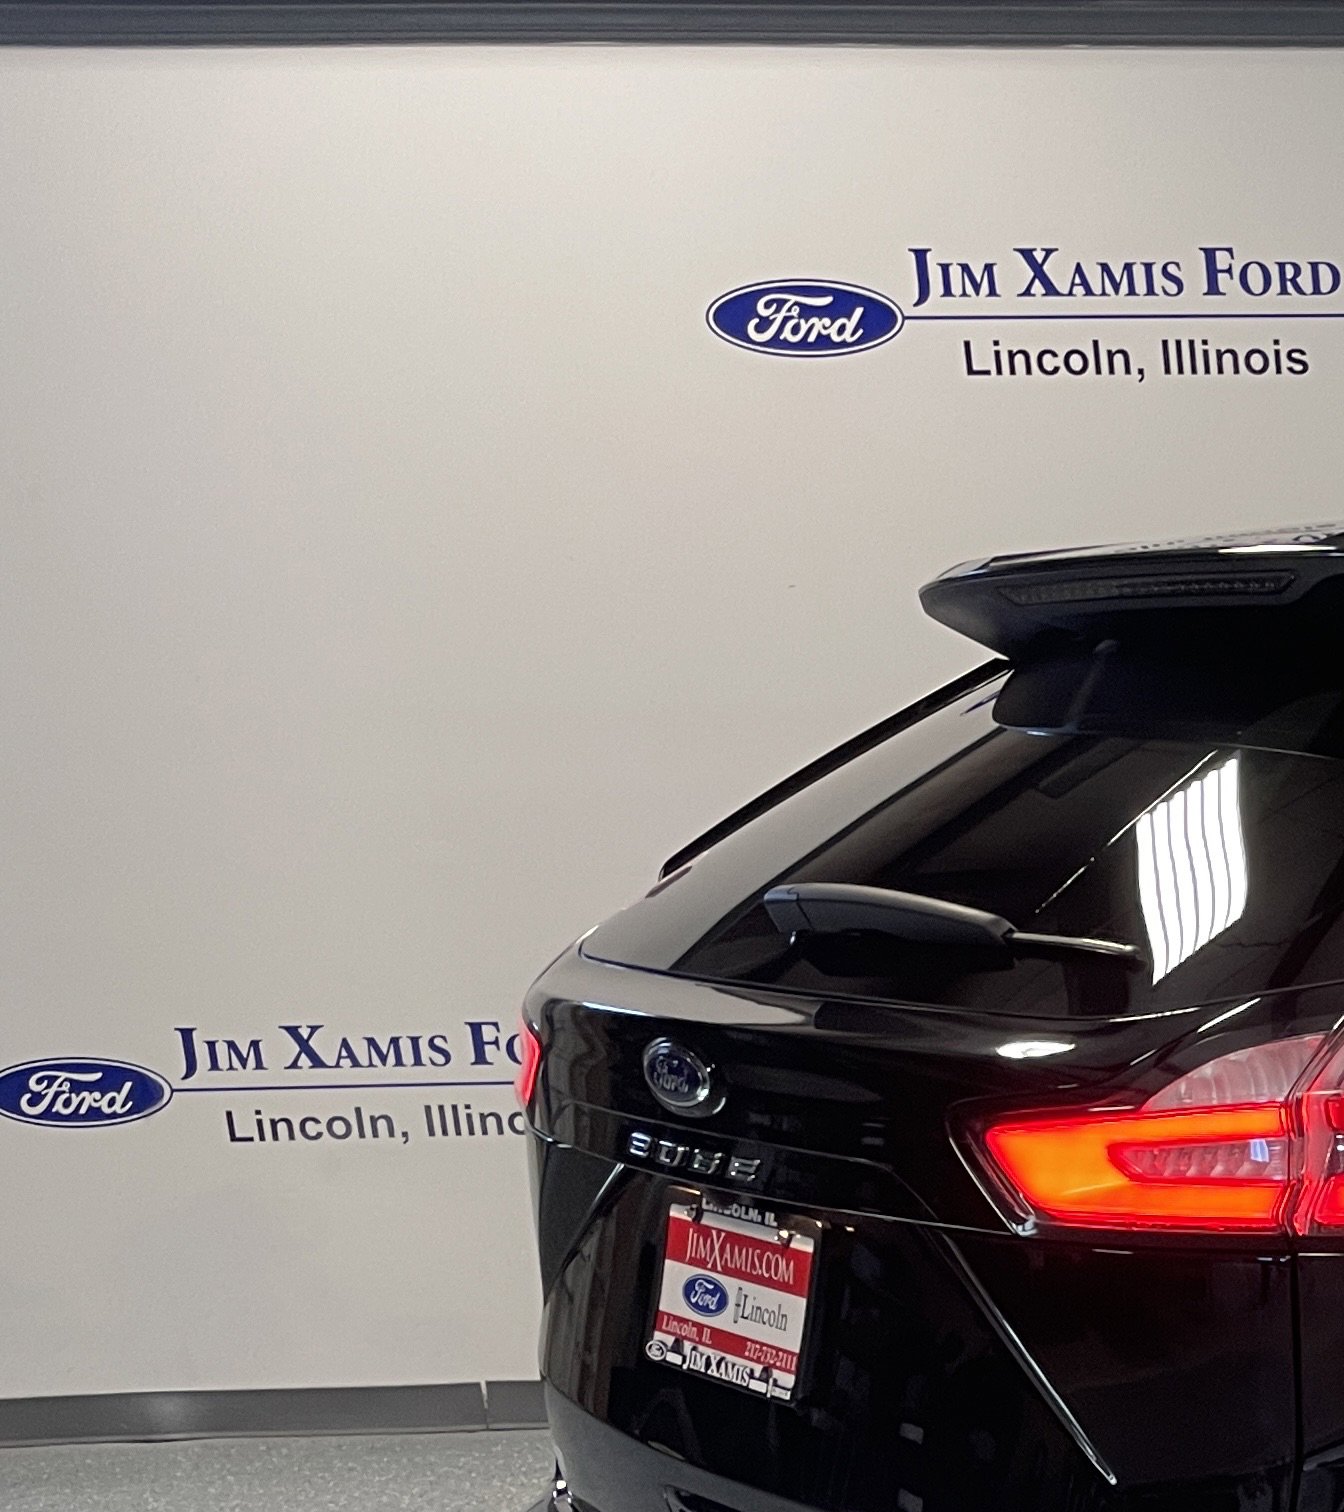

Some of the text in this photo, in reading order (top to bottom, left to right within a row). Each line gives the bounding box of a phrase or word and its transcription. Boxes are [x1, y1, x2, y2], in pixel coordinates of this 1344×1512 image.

[907, 247, 1341, 308] JIM XAMIS FORD
[745, 292, 864, 347] Ford
[963, 338, 1310, 383] Lincoln, Illinois
[173, 1027, 268, 1081] JIM
[277, 1024, 452, 1070] XAMIS
[19, 1069, 134, 1117] Ford
[225, 1106, 409, 1145] Lincoln,
[689, 1279, 721, 1311] Ford
[740, 1293, 788, 1332] Lincoln
[661, 1315, 713, 1345] Lincoln, IL
[682, 1345, 750, 1387] JIM XAMIS
